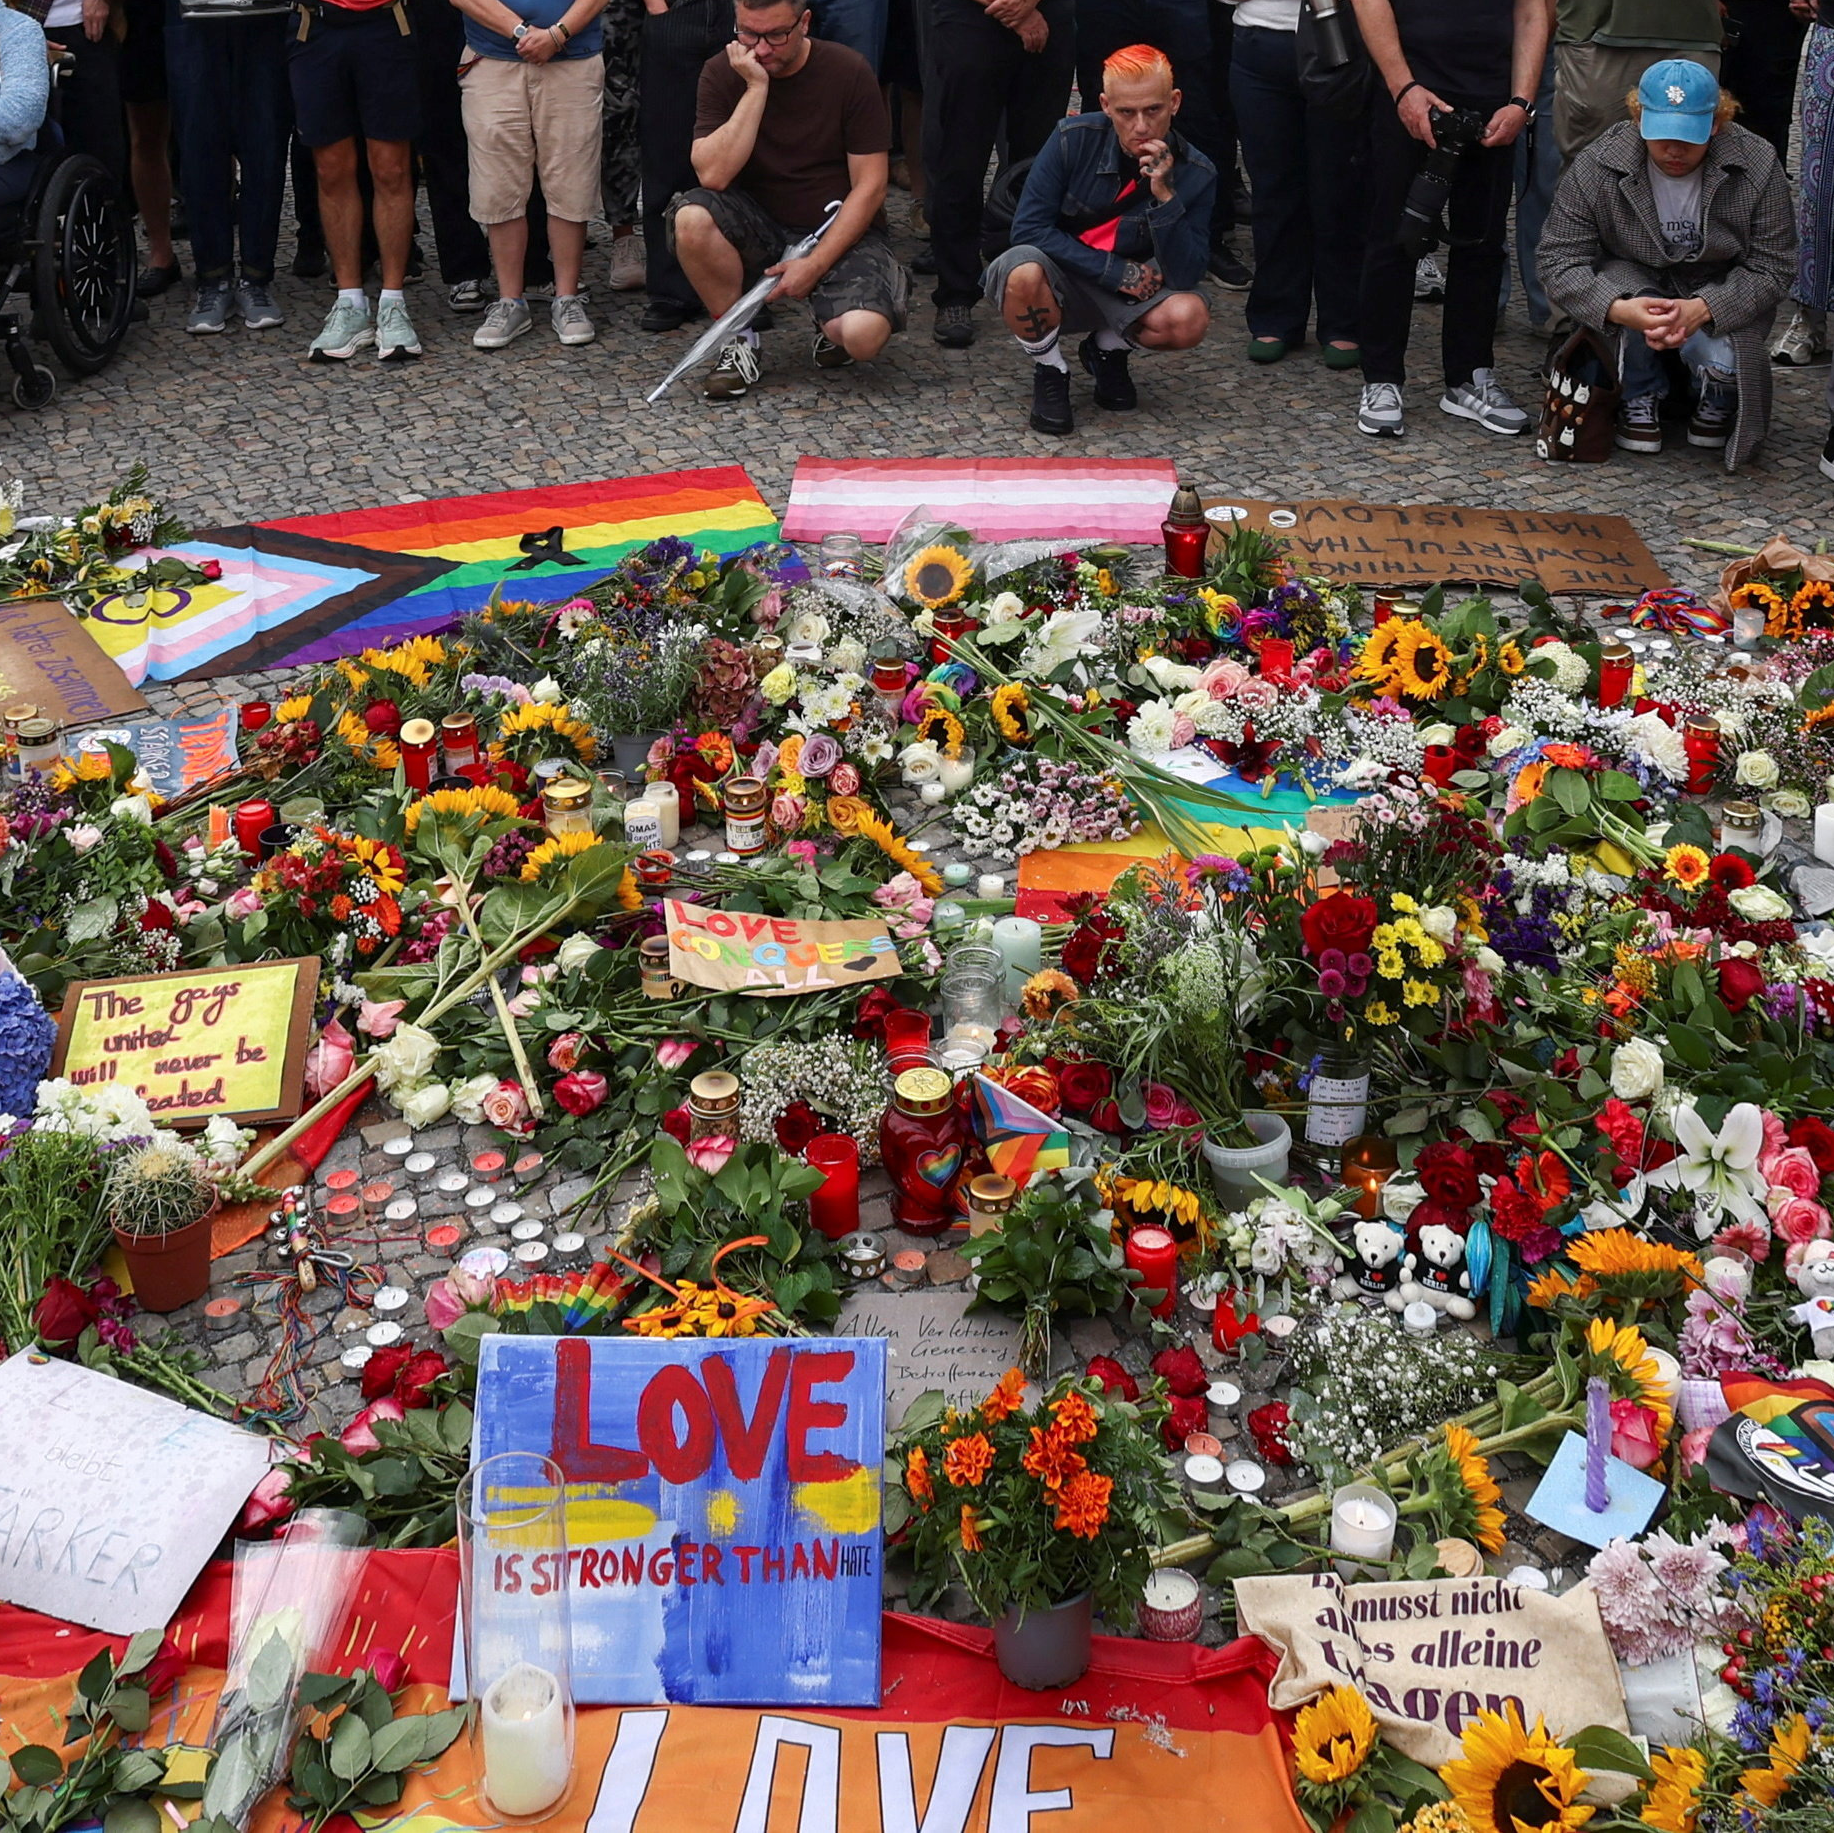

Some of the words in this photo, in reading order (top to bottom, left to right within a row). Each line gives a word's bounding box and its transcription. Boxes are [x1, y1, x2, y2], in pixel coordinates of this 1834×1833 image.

[1425, 510, 1464, 528] IS
[1487, 516, 1604, 540] HATE
[1389, 538, 1638, 568] POWERFUL
[1309, 560, 1434, 578] THING
[1448, 562, 1542, 582] ONLY
[1562, 569, 1647, 587] THE
[38, 653, 112, 722] zusammen
[628, 821, 657, 834] OMAS
[671, 898, 803, 946] LOVE
[671, 929, 896, 968] CONQUERS
[743, 963, 835, 992] ALL
[84, 992, 144, 1023] The
[167, 982, 241, 1026] gays
[104, 1025, 181, 1053] united
[70, 1061, 118, 1087] will
[155, 1053, 222, 1075] never
[236, 1037, 268, 1065] be
[1359, 1277, 1386, 1290] BERLIN
[1363, 1268, 1370, 1279] I
[1421, 1276, 1448, 1292] BERLIN
[1427, 1268, 1435, 1279] I
[836, 1313, 898, 1338] Allen
[894, 1363, 1001, 1391] Betroffenen
[551, 1338, 864, 1486] LOVE
[493, 1552, 524, 1594] IS
[531, 1543, 722, 1596] STRONGER
[731, 1537, 840, 1584] THAN
[840, 1538, 873, 1579] HATE
[1351, 1586, 1444, 1624] musst
[1451, 1579, 1526, 1616] nicht
[1410, 1628, 1542, 1670] alleine
